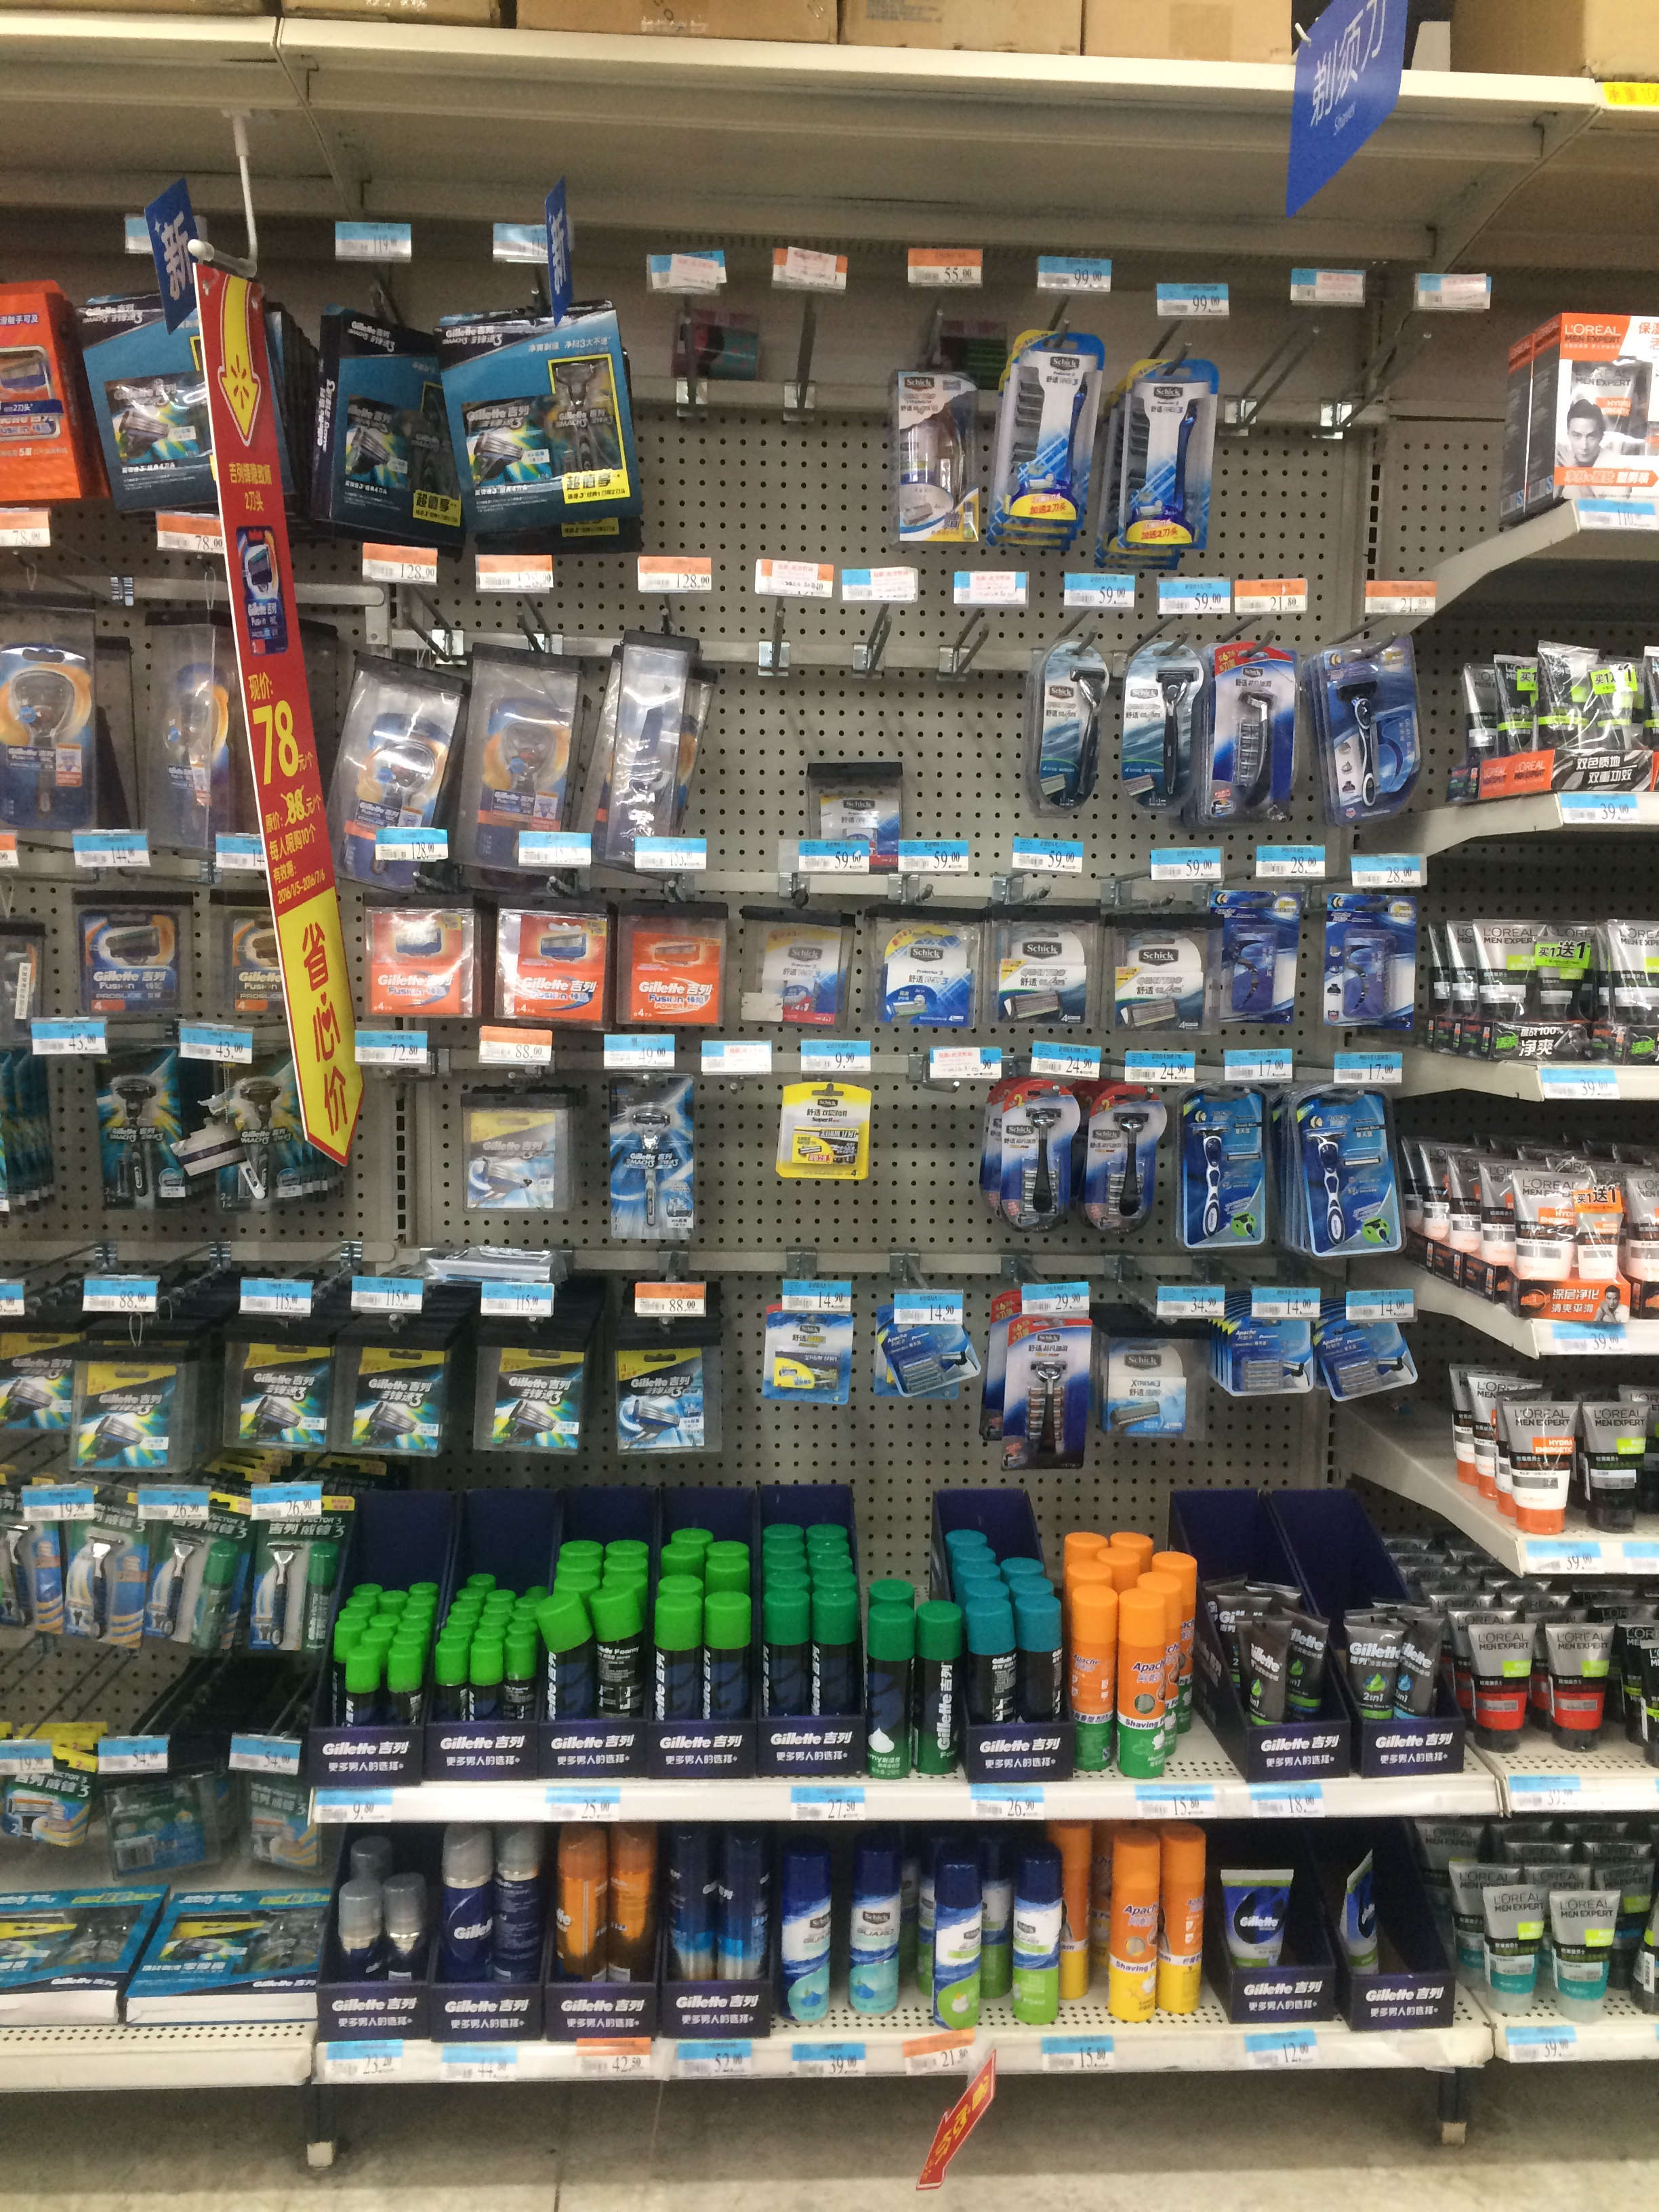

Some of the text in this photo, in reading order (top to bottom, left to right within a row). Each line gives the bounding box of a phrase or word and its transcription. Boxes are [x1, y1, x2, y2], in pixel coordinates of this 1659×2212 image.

[401, 563, 435, 580] 128.00
[1099, 587, 1126, 606] 59.00
[1194, 593, 1221, 610] 59.00
[1270, 596, 1297, 612] 21.80
[252, 700, 299, 785] 78
[1601, 805, 1629, 820] 39.00
[411, 842, 434, 860] 128.00
[934, 851, 960, 869] 59.00
[1048, 853, 1075, 870] 59.00
[1186, 859, 1212, 877] 59.00
[1291, 857, 1317, 875] 28.00
[1387, 865, 1412, 884] 28.00
[913, 949, 941, 958] Schick
[1027, 944, 1057, 954] Schick
[1142, 950, 1174, 961] Schick
[93, 970, 166, 982] Gillette 吉列
[377, 975, 425, 987] Gillette
[520, 977, 598, 993] Gillette 吉列
[639, 982, 713, 995] Gillette 吉列
[302, 922, 348, 1135] 省心价
[216, 1042, 243, 1059] 43.00
[391, 1043, 418, 1062] 72.80
[516, 1045, 542, 1059] 88.00
[835, 1052, 855, 1070] 9.90
[1066, 1055, 1092, 1074] 24.90
[1258, 1059, 1284, 1077] 17.00
[1160, 1062, 1187, 1081] 24.90
[1368, 1063, 1394, 1081] 17.00
[119, 1292, 147, 1309] 88.00
[817, 1291, 843, 1309] 14.90
[1055, 1292, 1081, 1311] 29.90
[1553, 1289, 1599, 1300] 深层净化
[670, 1298, 695, 1313] 88.00
[929, 1304, 954, 1321] 14.90
[1191, 1296, 1216, 1314] 34.90
[1286, 1298, 1311, 1316] 14.00
[1380, 1299, 1405, 1317] 14.00
[173, 1502, 199, 1519] 26.90
[285, 1500, 312, 1517] 26.90
[937, 1694, 952, 1750] Gillette
[440, 1735, 525, 1750] Gillette 吉列
[551, 1734, 635, 1750] Gillette 吉列
[660, 1734, 742, 1749] Gillette 吉列
[771, 1730, 853, 1746] Gillette 吉列
[979, 1737, 1061, 1754] Gillette 吉列
[1261, 1735, 1340, 1753] Gillette 吉列
[1375, 1732, 1454, 1749] Gillette 吉列
[322, 1740, 409, 1756] Gillette 吉列
[776, 1751, 843, 1761] 更多男人的选择
[328, 1761, 398, 1772] 更多男人的选择
[446, 1756, 515, 1767] 更多男人的选择
[557, 1754, 625, 1766] 更多男人的选择
[665, 1755, 733, 1765] 更多男人的选择
[985, 1758, 1051, 1769] 更多男人的选择
[1266, 1755, 1330, 1767] 更多男人的选择
[1380, 1752, 1443, 1764] 更多男人的选择
[352, 1801, 374, 1820] 9.80
[828, 1798, 856, 1820] 27.50
[1007, 1797, 1035, 1818] 26.90
[1173, 1795, 1200, 1817] 15.80
[1288, 1795, 1315, 1815] 18.00
[1240, 1917, 1279, 1928] Gillette
[1244, 1980, 1323, 1996] Gillette 吉列
[1366, 1986, 1444, 2002] Gillette 吉列
[331, 1997, 417, 2012] Gillette 吉列
[445, 1999, 529, 2013] Gillette 吉列
[561, 1999, 644, 2013] Gillette 吉列
[676, 1994, 759, 2009] Gillette 吉列
[941, 2049, 968, 2068] 21.80
[1080, 2046, 1106, 2068] 15.80
[1283, 2042, 1309, 2063] 12.00
[612, 2055, 642, 2074] 42.50
[715, 2052, 743, 2072] 52.00
[830, 2054, 857, 2074] 39.00
